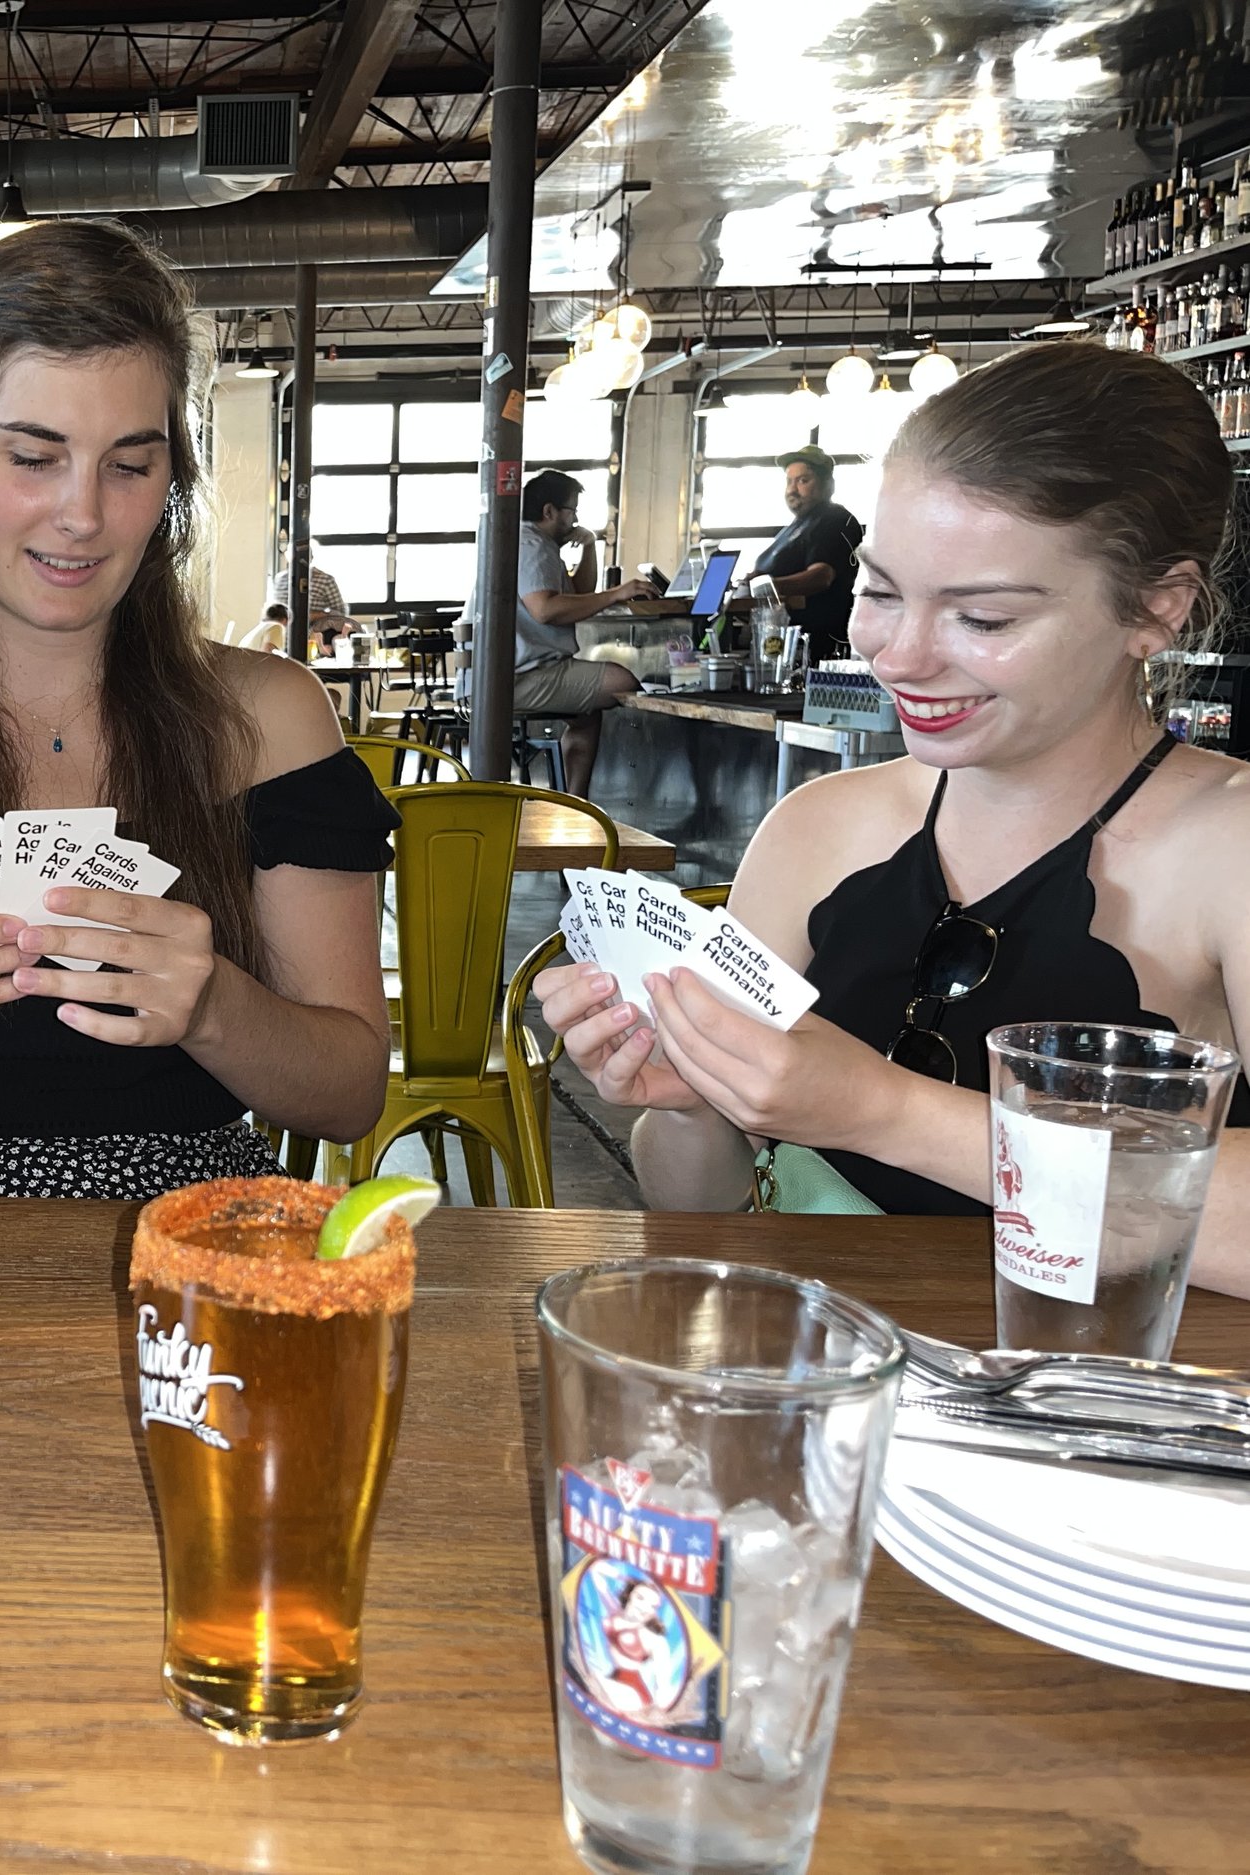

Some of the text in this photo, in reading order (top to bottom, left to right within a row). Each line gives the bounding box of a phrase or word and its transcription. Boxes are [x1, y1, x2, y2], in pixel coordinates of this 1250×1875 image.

[81, 856, 141, 891] Against
[94, 843, 138, 873] Cards
[637, 902, 696, 941] Agains
[638, 887, 687, 922] Cards
[636, 915, 686, 952] Huma
[720, 923, 770, 971] Cards
[703, 942, 782, 1017] Humanity
[710, 935, 775, 994] Against
